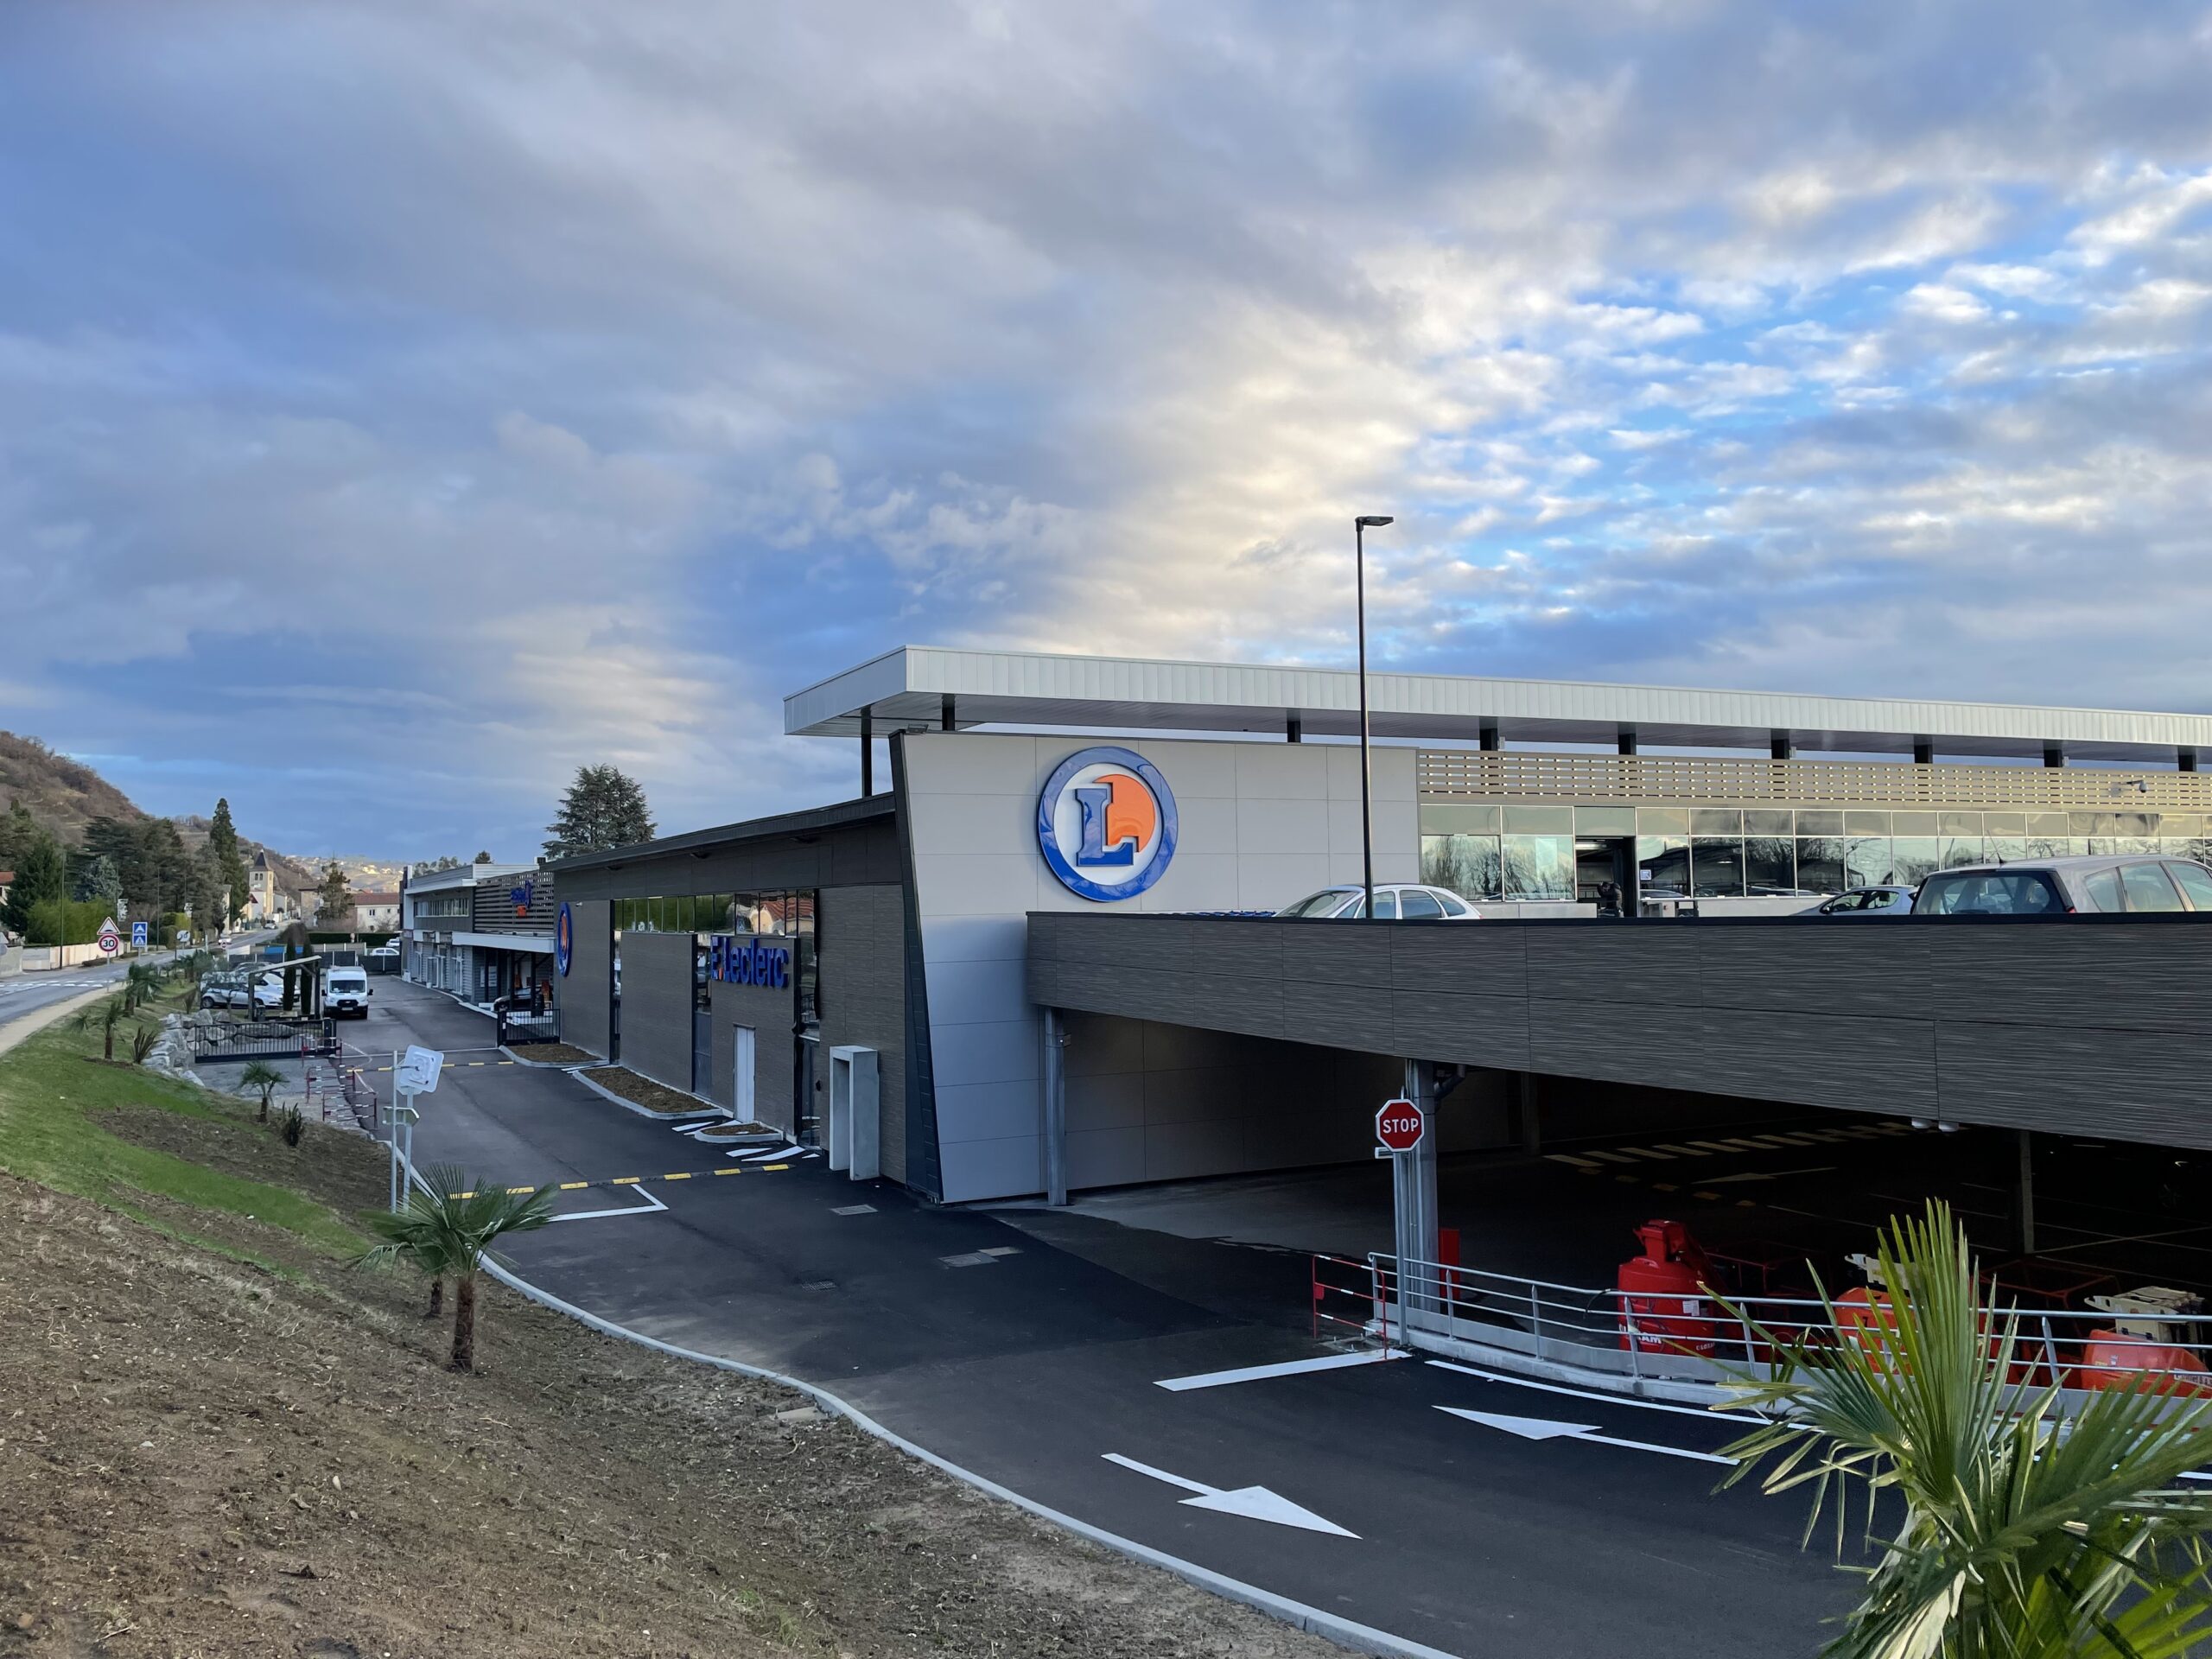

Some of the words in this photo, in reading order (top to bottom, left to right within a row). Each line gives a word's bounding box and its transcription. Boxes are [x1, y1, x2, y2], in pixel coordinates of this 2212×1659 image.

[1075, 787, 1134, 867] L
[711, 936, 789, 988] E.Leclerc
[1382, 1117, 1419, 1134] STOP
